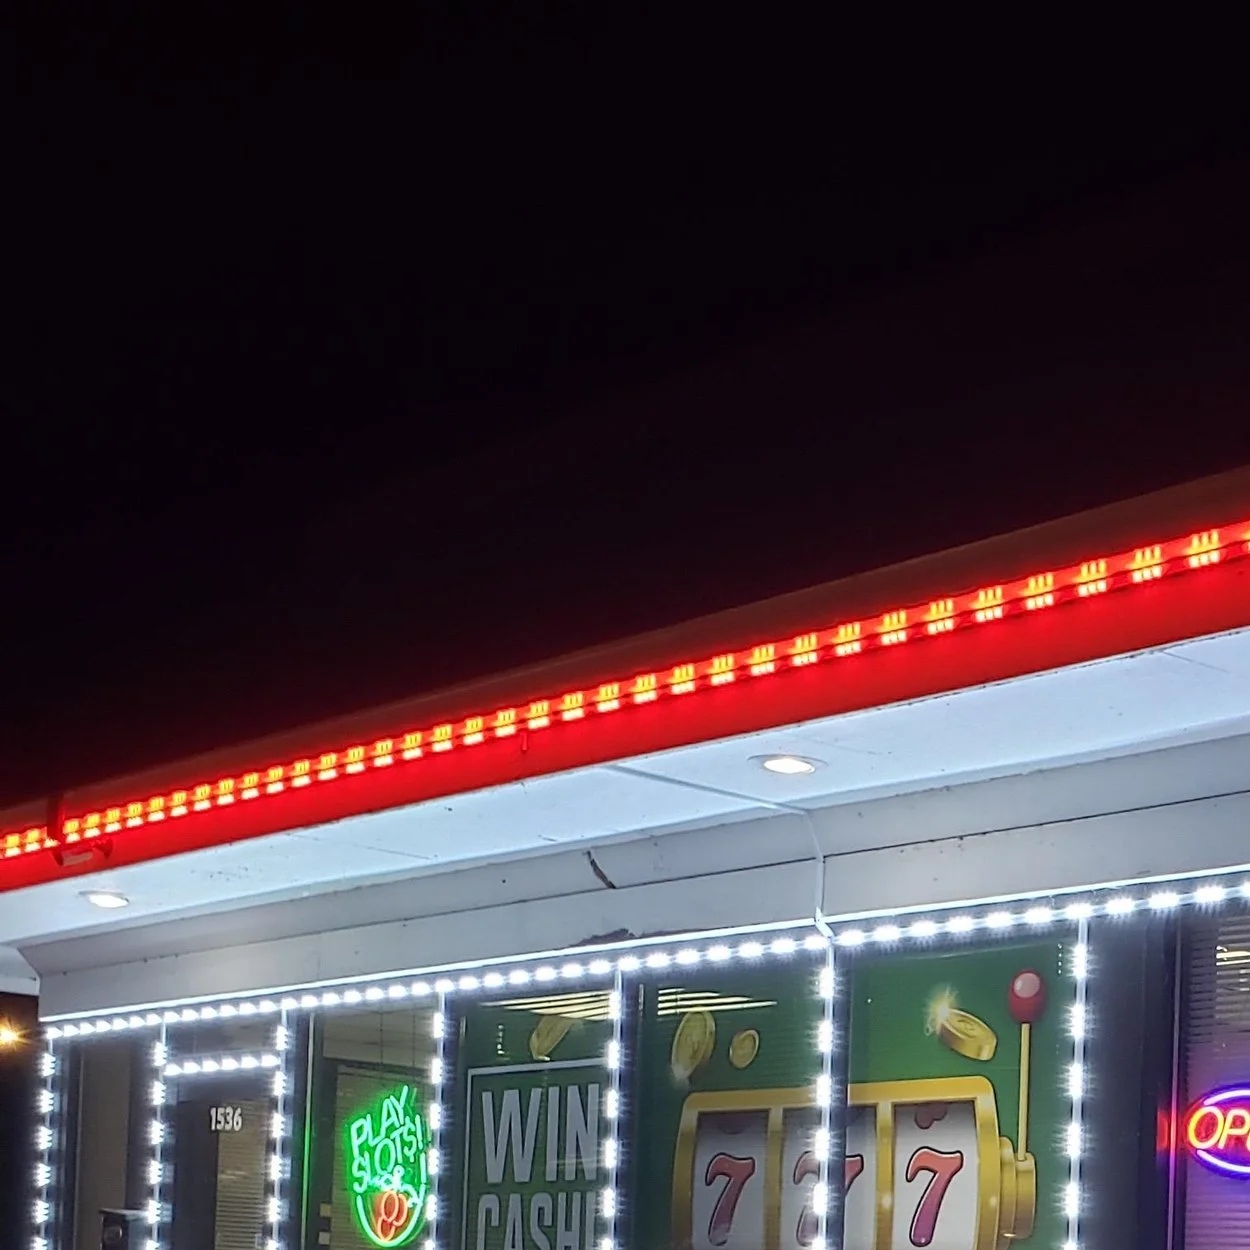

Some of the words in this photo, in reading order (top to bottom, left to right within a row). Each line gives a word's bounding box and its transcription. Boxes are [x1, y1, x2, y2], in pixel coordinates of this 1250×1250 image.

[210, 1106, 243, 1131] 1536
[350, 1085, 409, 1161] PLAY
[481, 1083, 600, 1184] WIN
